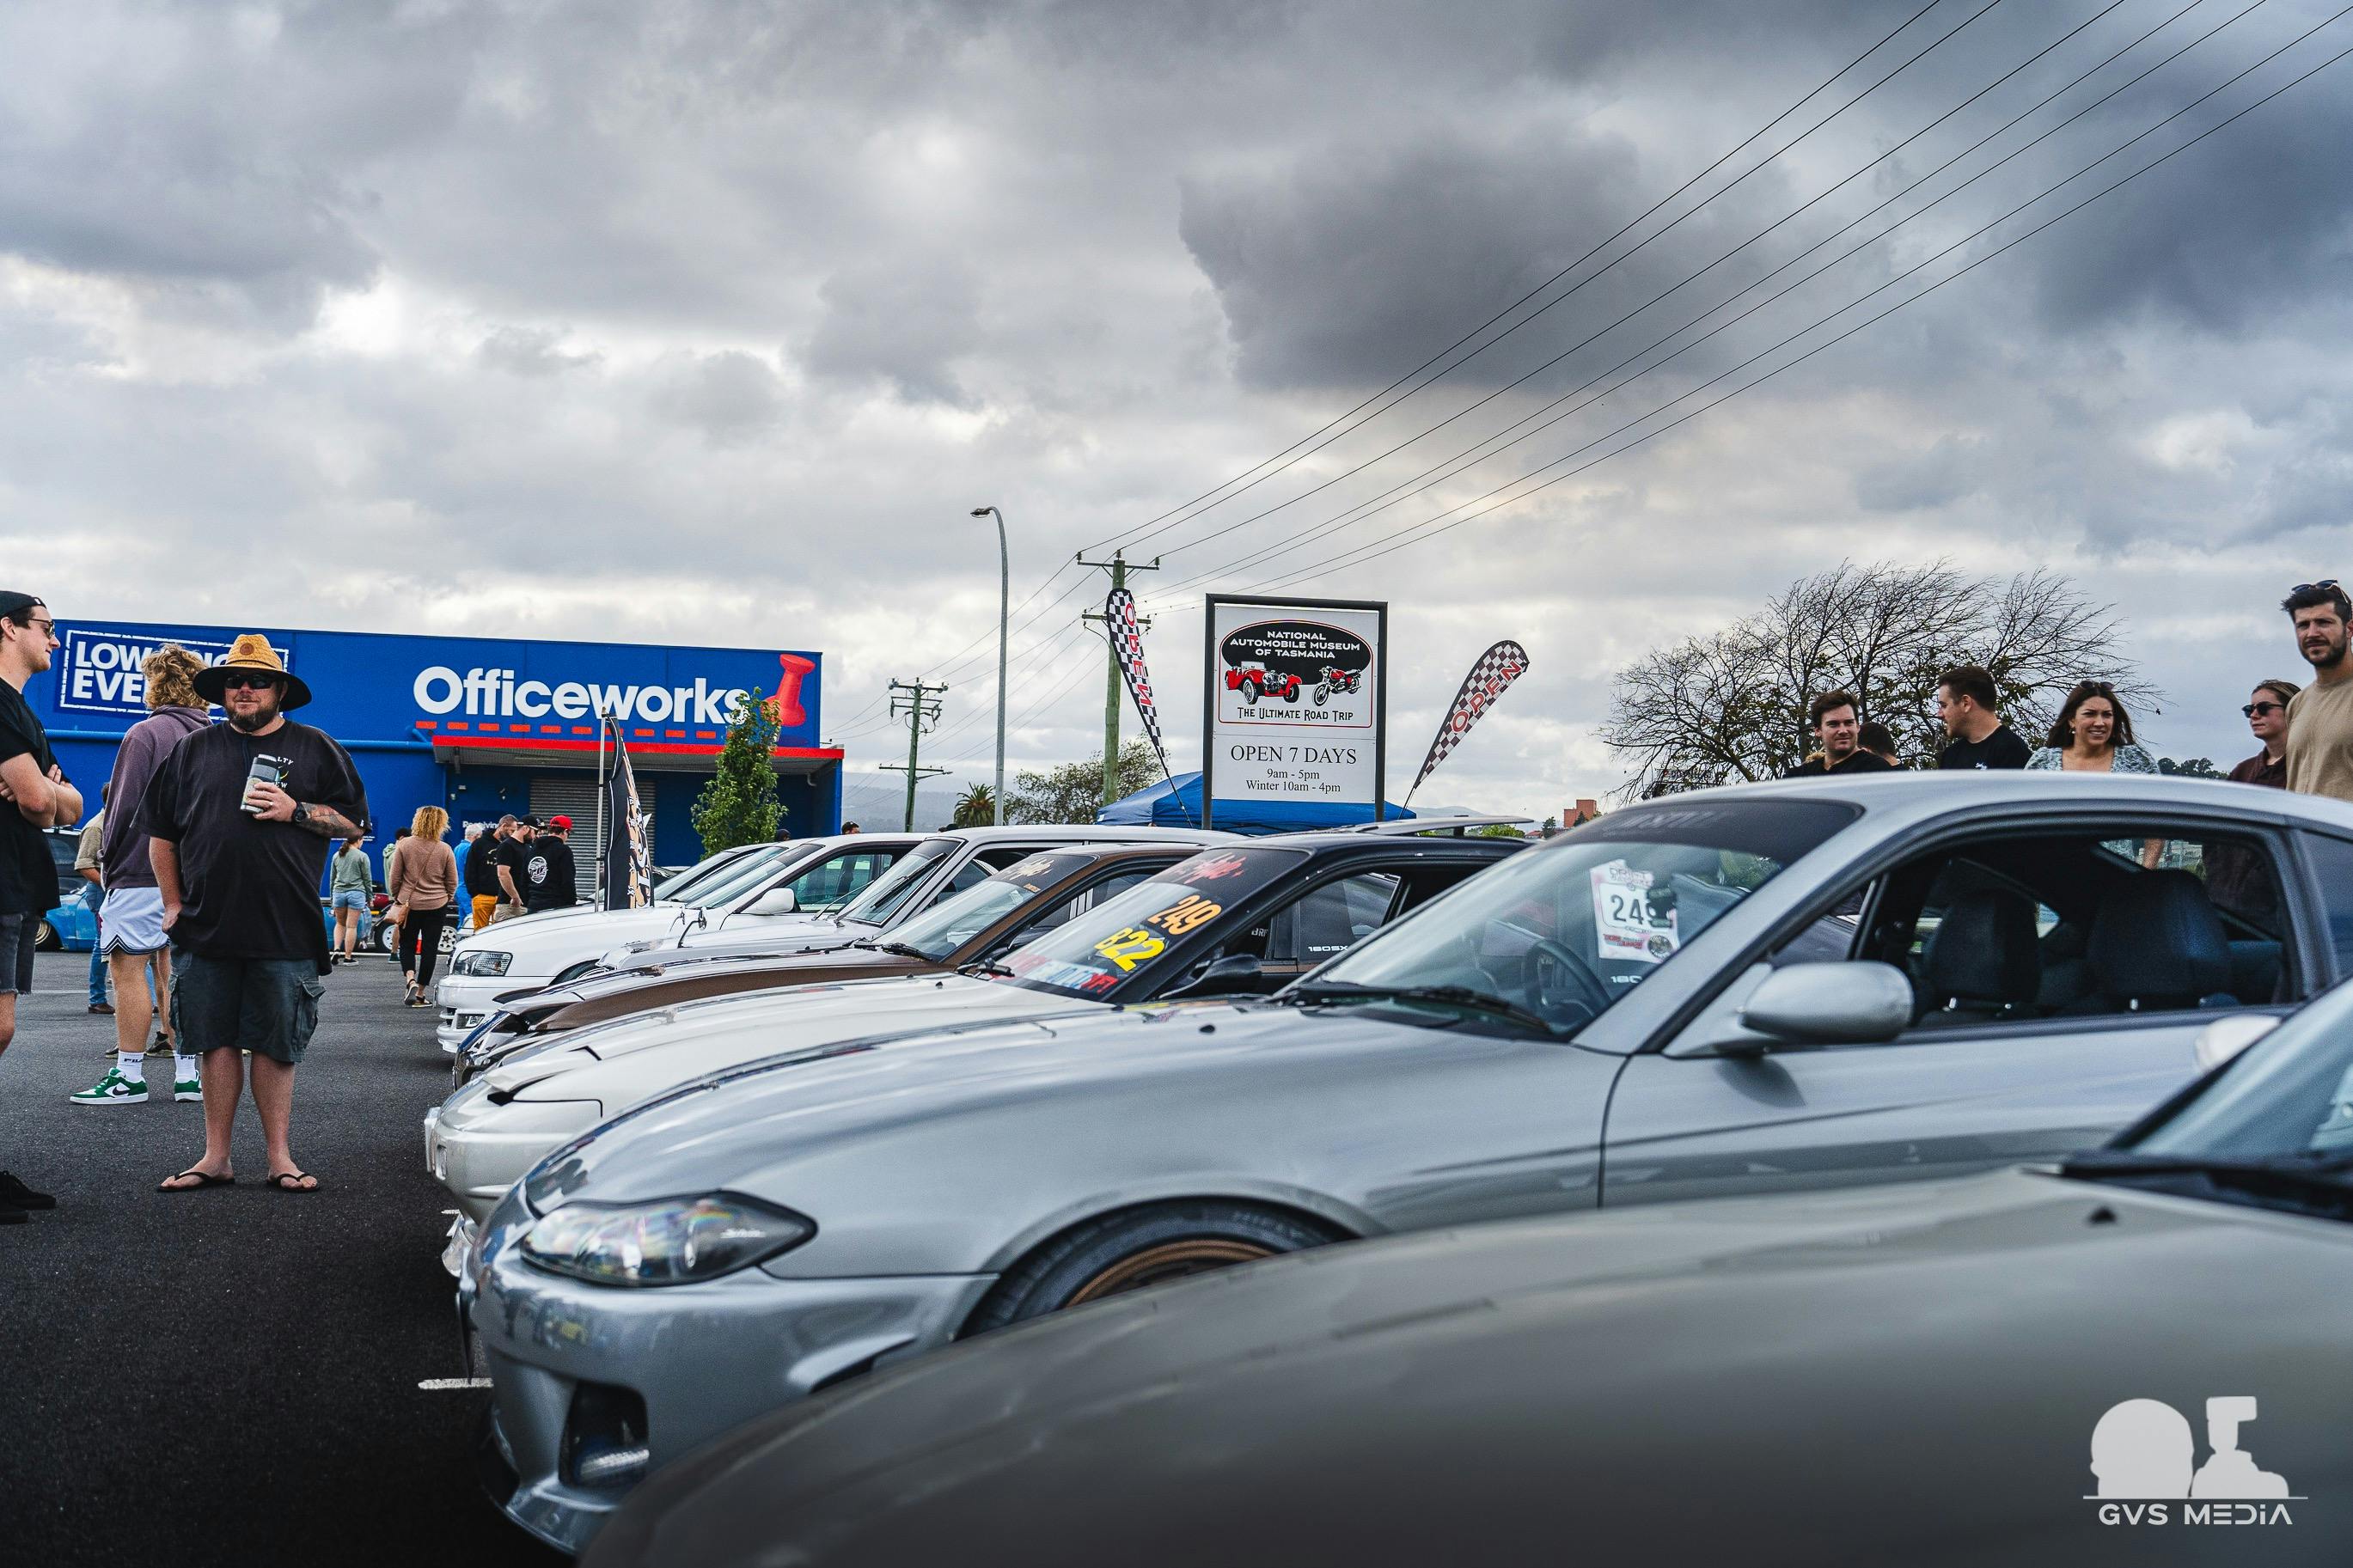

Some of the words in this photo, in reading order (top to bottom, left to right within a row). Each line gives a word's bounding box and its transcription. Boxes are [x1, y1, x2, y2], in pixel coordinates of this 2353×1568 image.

[1230, 638, 1306, 649] AUTOMOBILE
[1310, 642, 1360, 651] MUSEUM
[1267, 631, 1327, 640] NATIONAL
[75, 640, 153, 673] LOW
[1255, 648, 1272, 656] OF
[1274, 649, 1335, 659] TASMANIA
[72, 668, 148, 705] EVE
[413, 666, 751, 725] Officeworks
[1451, 661, 1522, 733] OPEN
[1237, 707, 1256, 719] THE
[1259, 707, 1301, 720] ULTIMATE
[1304, 709, 1329, 722] ROAD
[1332, 710, 1354, 723] TRIP
[277, 756, 294, 765] LTY
[1231, 745, 1284, 762] OPEN
[1289, 747, 1299, 763] 7
[1304, 747, 1357, 765] DAYS
[1267, 768, 1288, 778] 9am
[1298, 769, 1320, 781] 5pm
[1246, 780, 1280, 790] Winter
[1283, 781, 1309, 791] 10am
[1318, 782, 1342, 794] 4pm
[1147, 894, 1222, 936] 249
[1610, 894, 1645, 925] 24
[1094, 927, 1164, 972] B22
